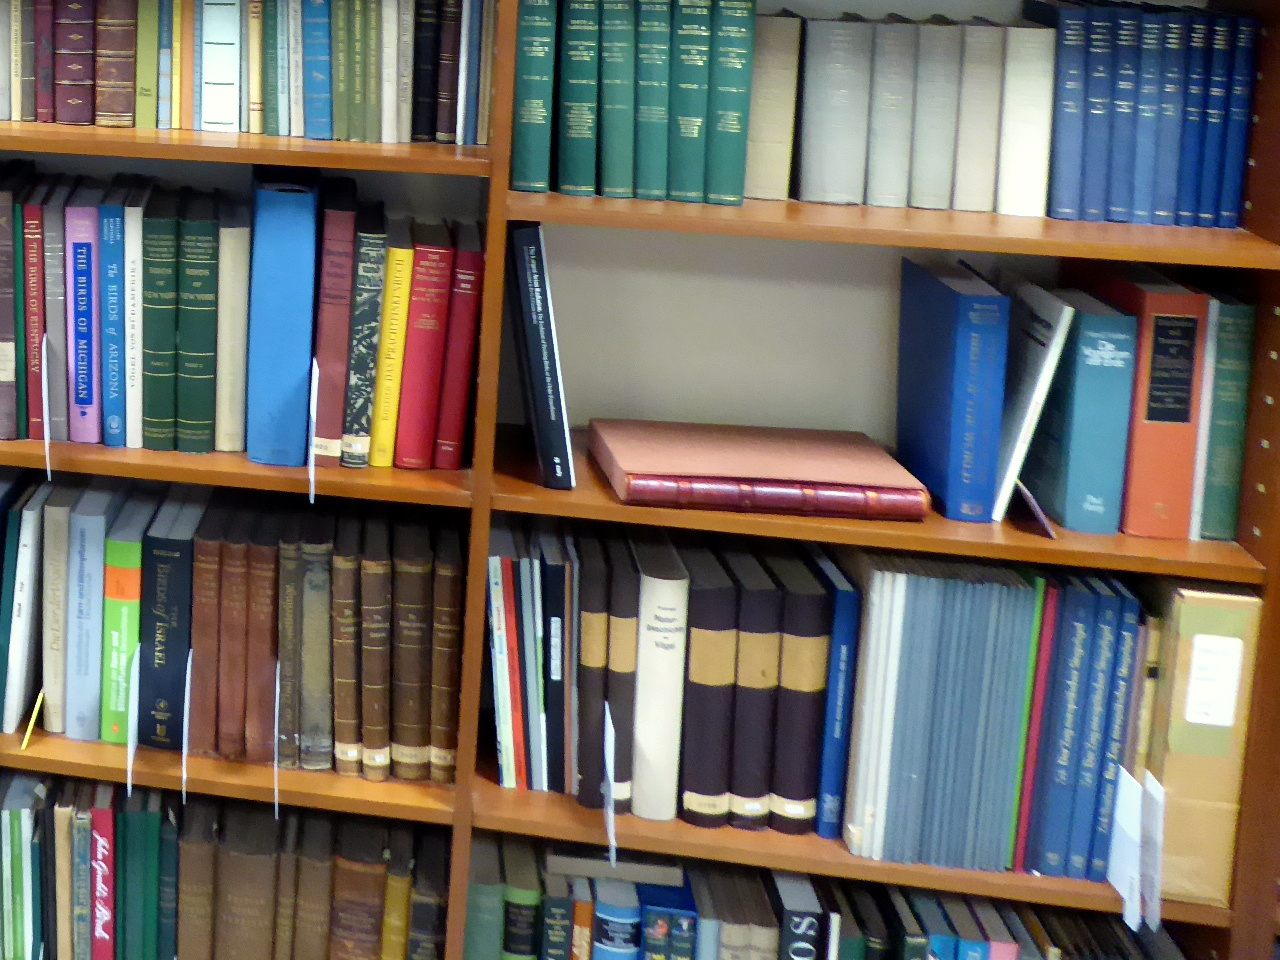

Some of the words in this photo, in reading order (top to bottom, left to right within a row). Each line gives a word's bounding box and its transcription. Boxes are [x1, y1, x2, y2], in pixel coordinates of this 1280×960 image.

[77, 247, 88, 270] THE
[107, 263, 119, 278] The
[29, 266, 39, 296] BIRDS
[78, 276, 88, 312] BIRDS
[108, 284, 119, 321] BIRDS
[77, 318, 88, 333] OF
[105, 327, 118, 336] of
[127, 333, 136, 350] VON
[30, 315, 40, 372] KENTUCKY
[78, 339, 89, 399] MICHIGAN
[109, 343, 120, 399] ARIZONA
[153, 622, 171, 669] ISRAEL
